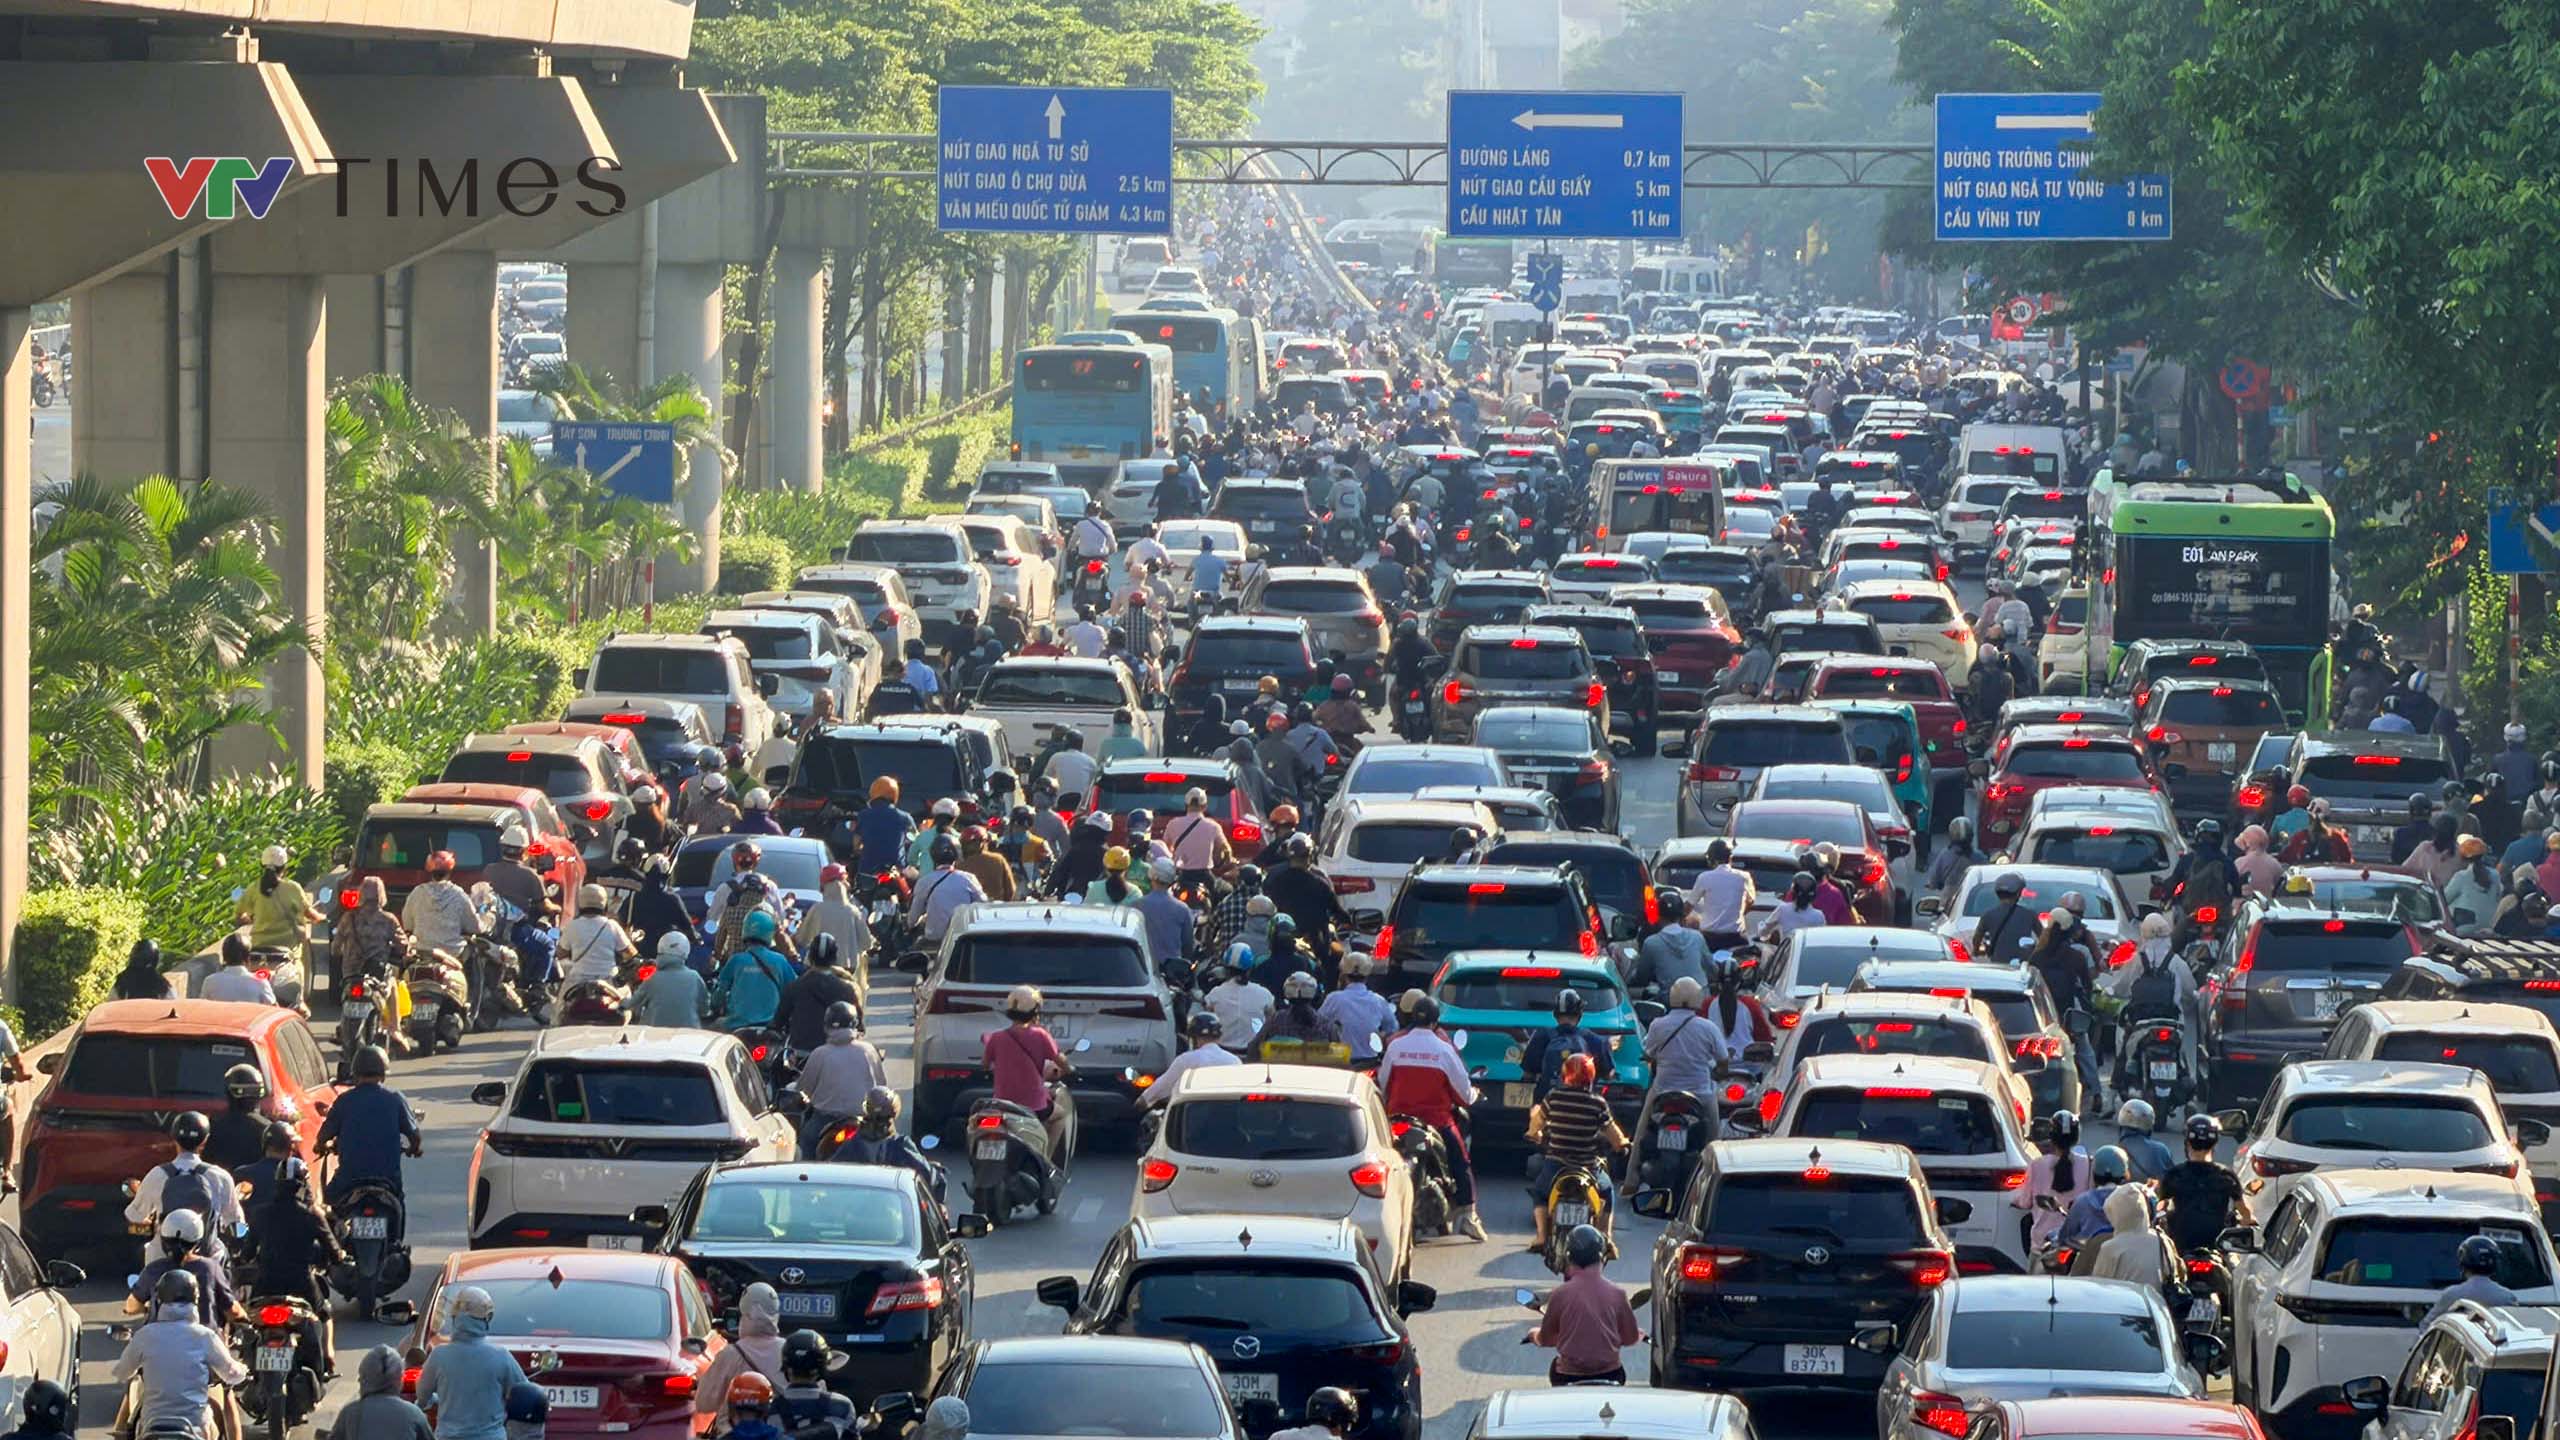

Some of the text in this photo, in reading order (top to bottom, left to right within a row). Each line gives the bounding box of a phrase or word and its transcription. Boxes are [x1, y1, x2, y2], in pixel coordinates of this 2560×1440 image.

[976, 143, 1006, 161] GIAO
[1513, 145, 1550, 167] LÁNG
[1624, 151, 1643, 167] 0.7
[1649, 151, 1670, 167] km
[2058, 151, 2094, 168] CHIN
[976, 173, 1006, 190] GIAO
[1119, 176, 1139, 192] 2.5
[1144, 177, 1165, 193] km
[1492, 179, 1523, 196] GIAO
[1636, 181, 1644, 197] 5
[1649, 181, 1670, 197] km
[1976, 181, 2007, 198] GIAO
[2127, 182, 2135, 197] 3
[2141, 182, 2163, 197] km
[1120, 206, 1140, 222] 4.3
[1144, 206, 1165, 222] km
[1631, 210, 1644, 226] 11
[1649, 210, 1670, 226] km
[2141, 211, 2163, 227] km
[1666, 470, 1708, 481] Sakura
[2183, 547, 2204, 562] E01
[2228, 550, 2259, 562] PARK
[1802, 1346, 1826, 1359] 30K
